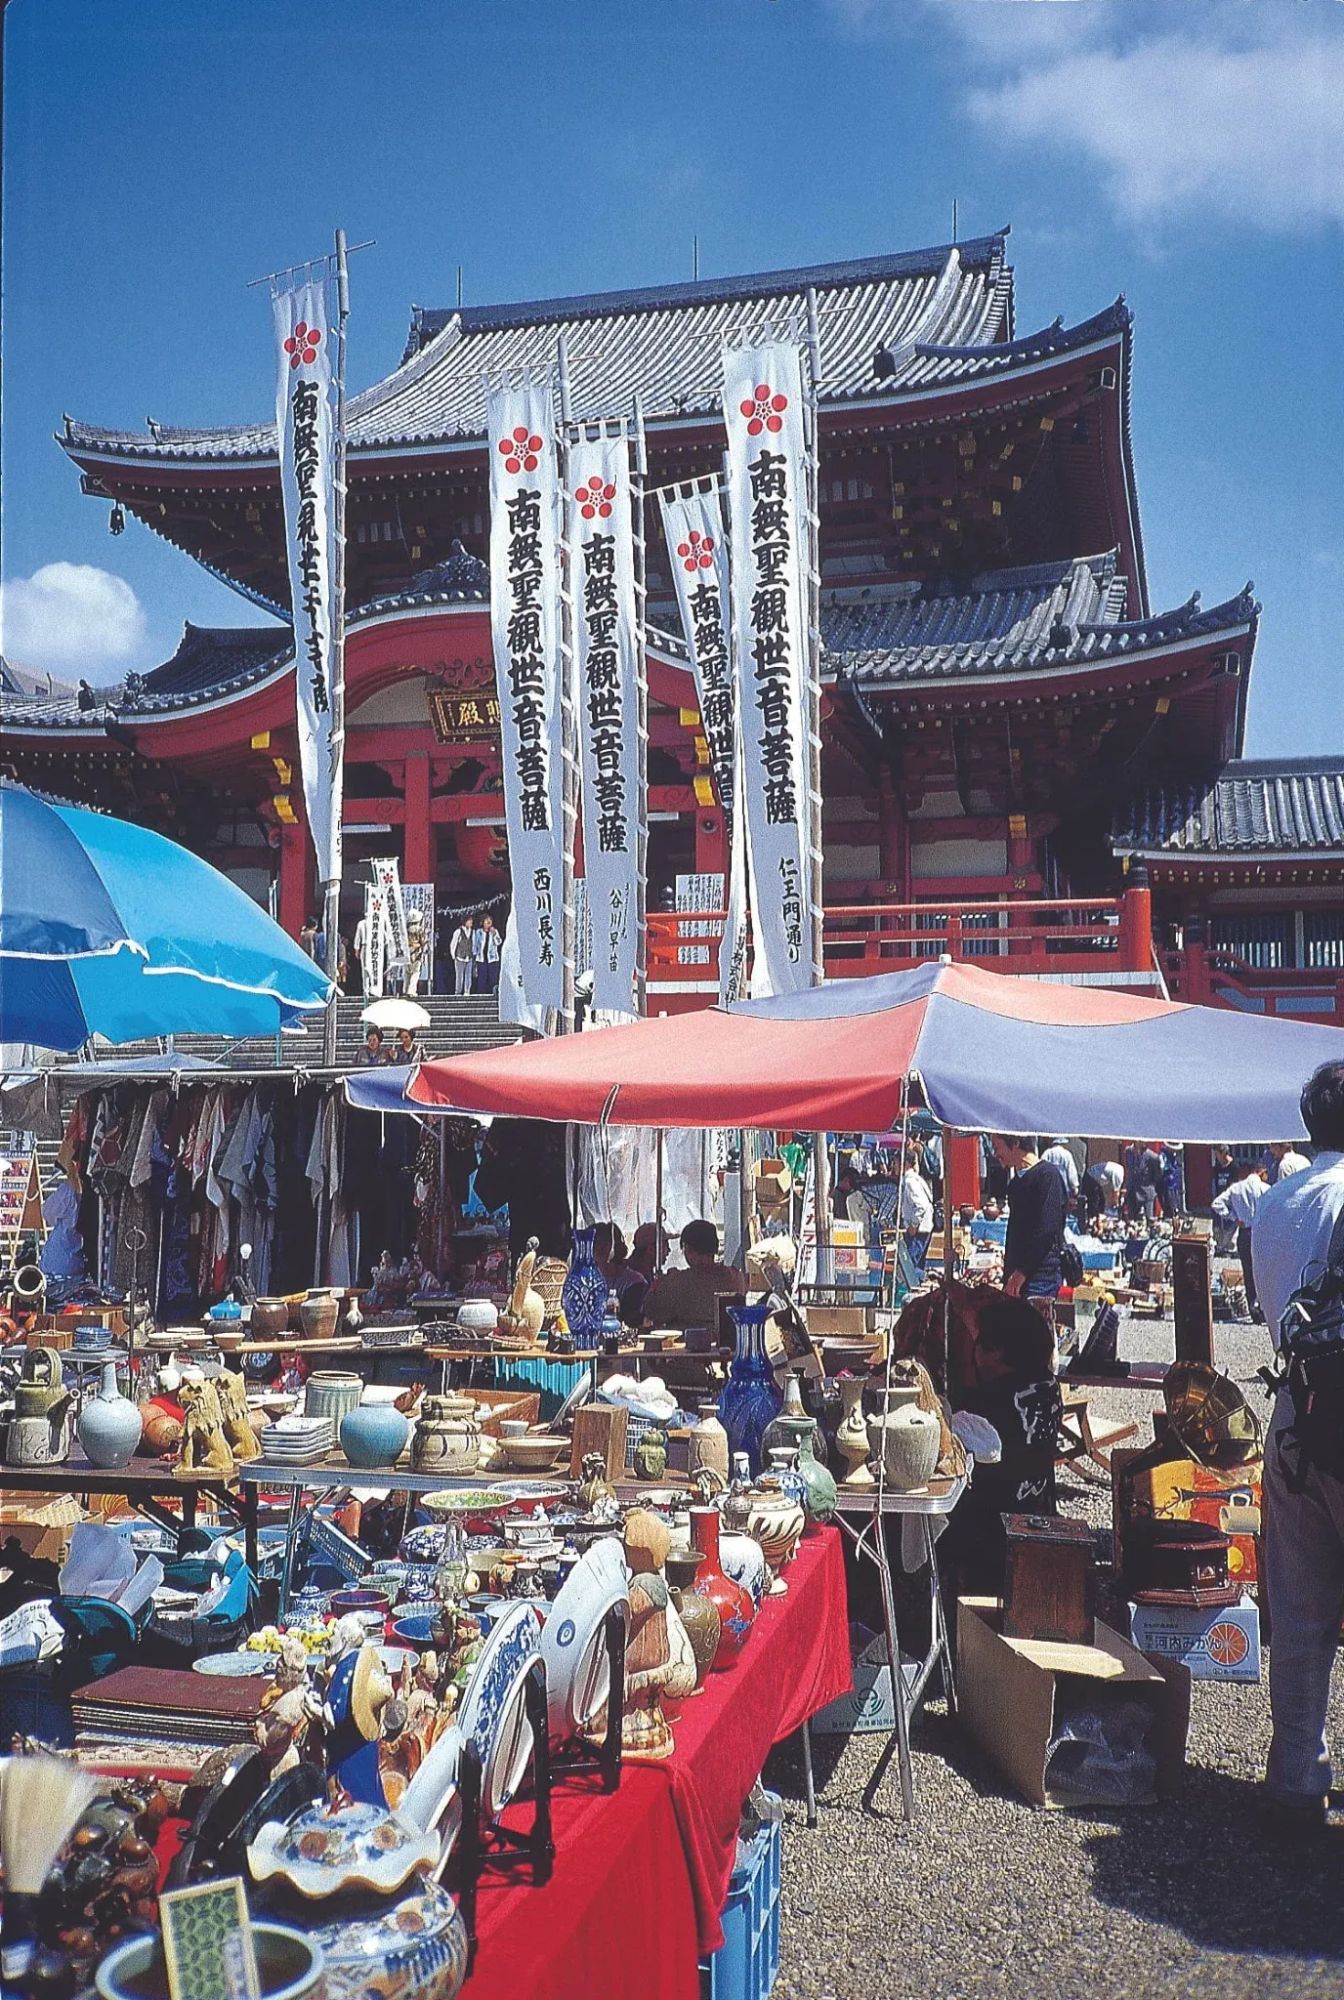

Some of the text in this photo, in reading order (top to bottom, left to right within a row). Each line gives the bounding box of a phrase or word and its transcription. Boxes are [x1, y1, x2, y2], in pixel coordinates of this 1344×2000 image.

[505, 488, 549, 832] 南無聖観世音菩薩
[581, 532, 628, 853] 南無聖観世音菩薩
[749, 450, 798, 825] 南無聖観世音菩薩
[533, 867, 554, 967] 西川長寿
[608, 887, 623, 973] 谷川早苗
[777, 857, 803, 964] 仁王門通り
